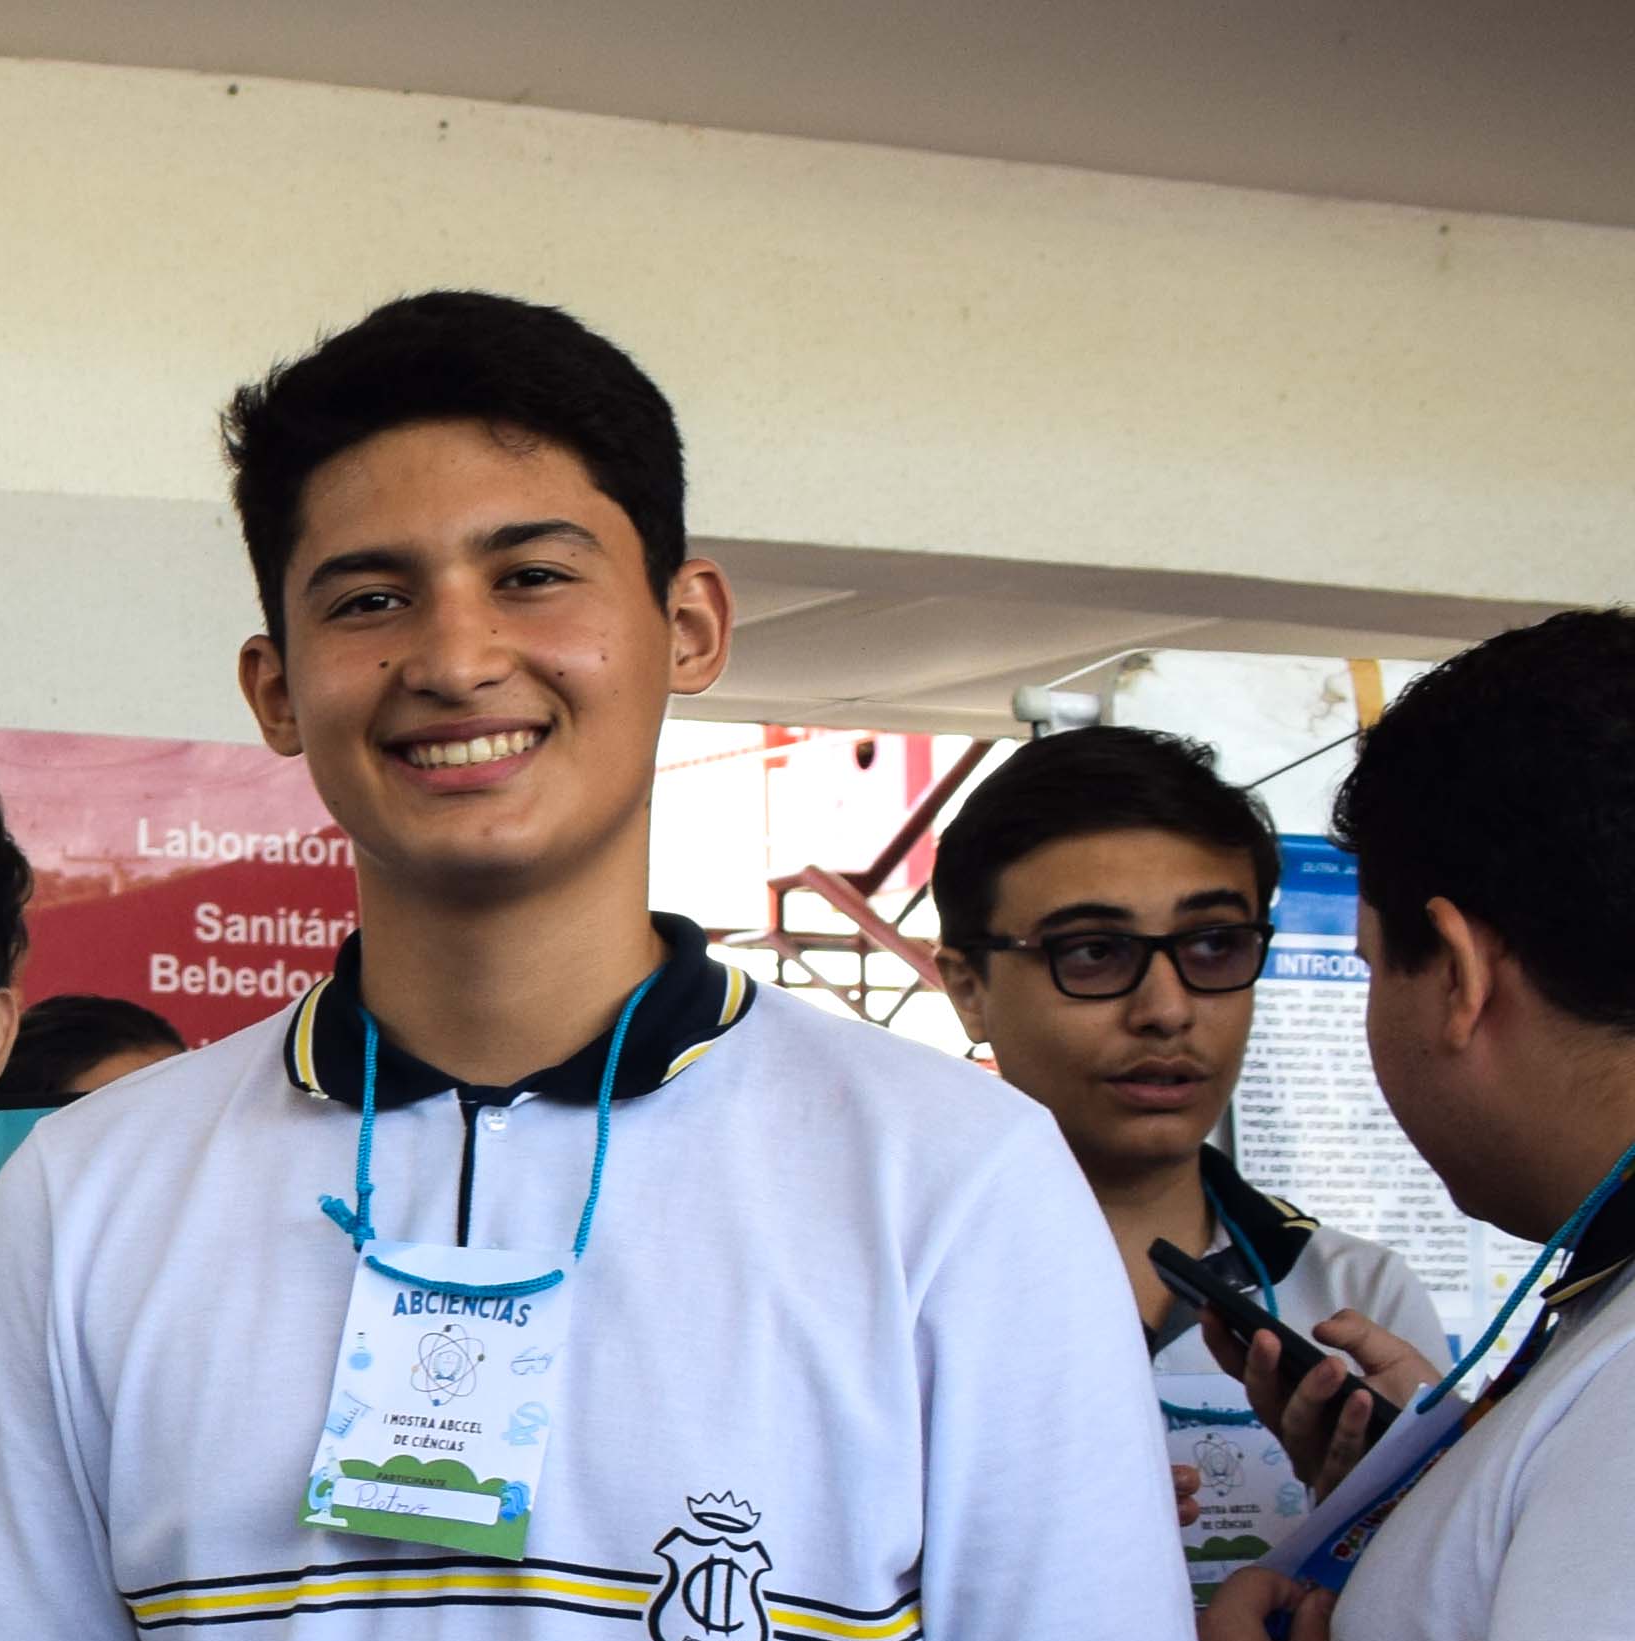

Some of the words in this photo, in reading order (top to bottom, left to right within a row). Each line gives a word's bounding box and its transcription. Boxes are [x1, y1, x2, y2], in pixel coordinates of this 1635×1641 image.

[137, 817, 355, 866] Laboratóri
[195, 903, 356, 947] Sanitári
[390, 1413, 435, 1429] MOSTRA
[439, 1418, 483, 1434] ABCCEL
[394, 1434, 408, 1446] DE
[411, 1434, 465, 1452] CIÊNCIAS
